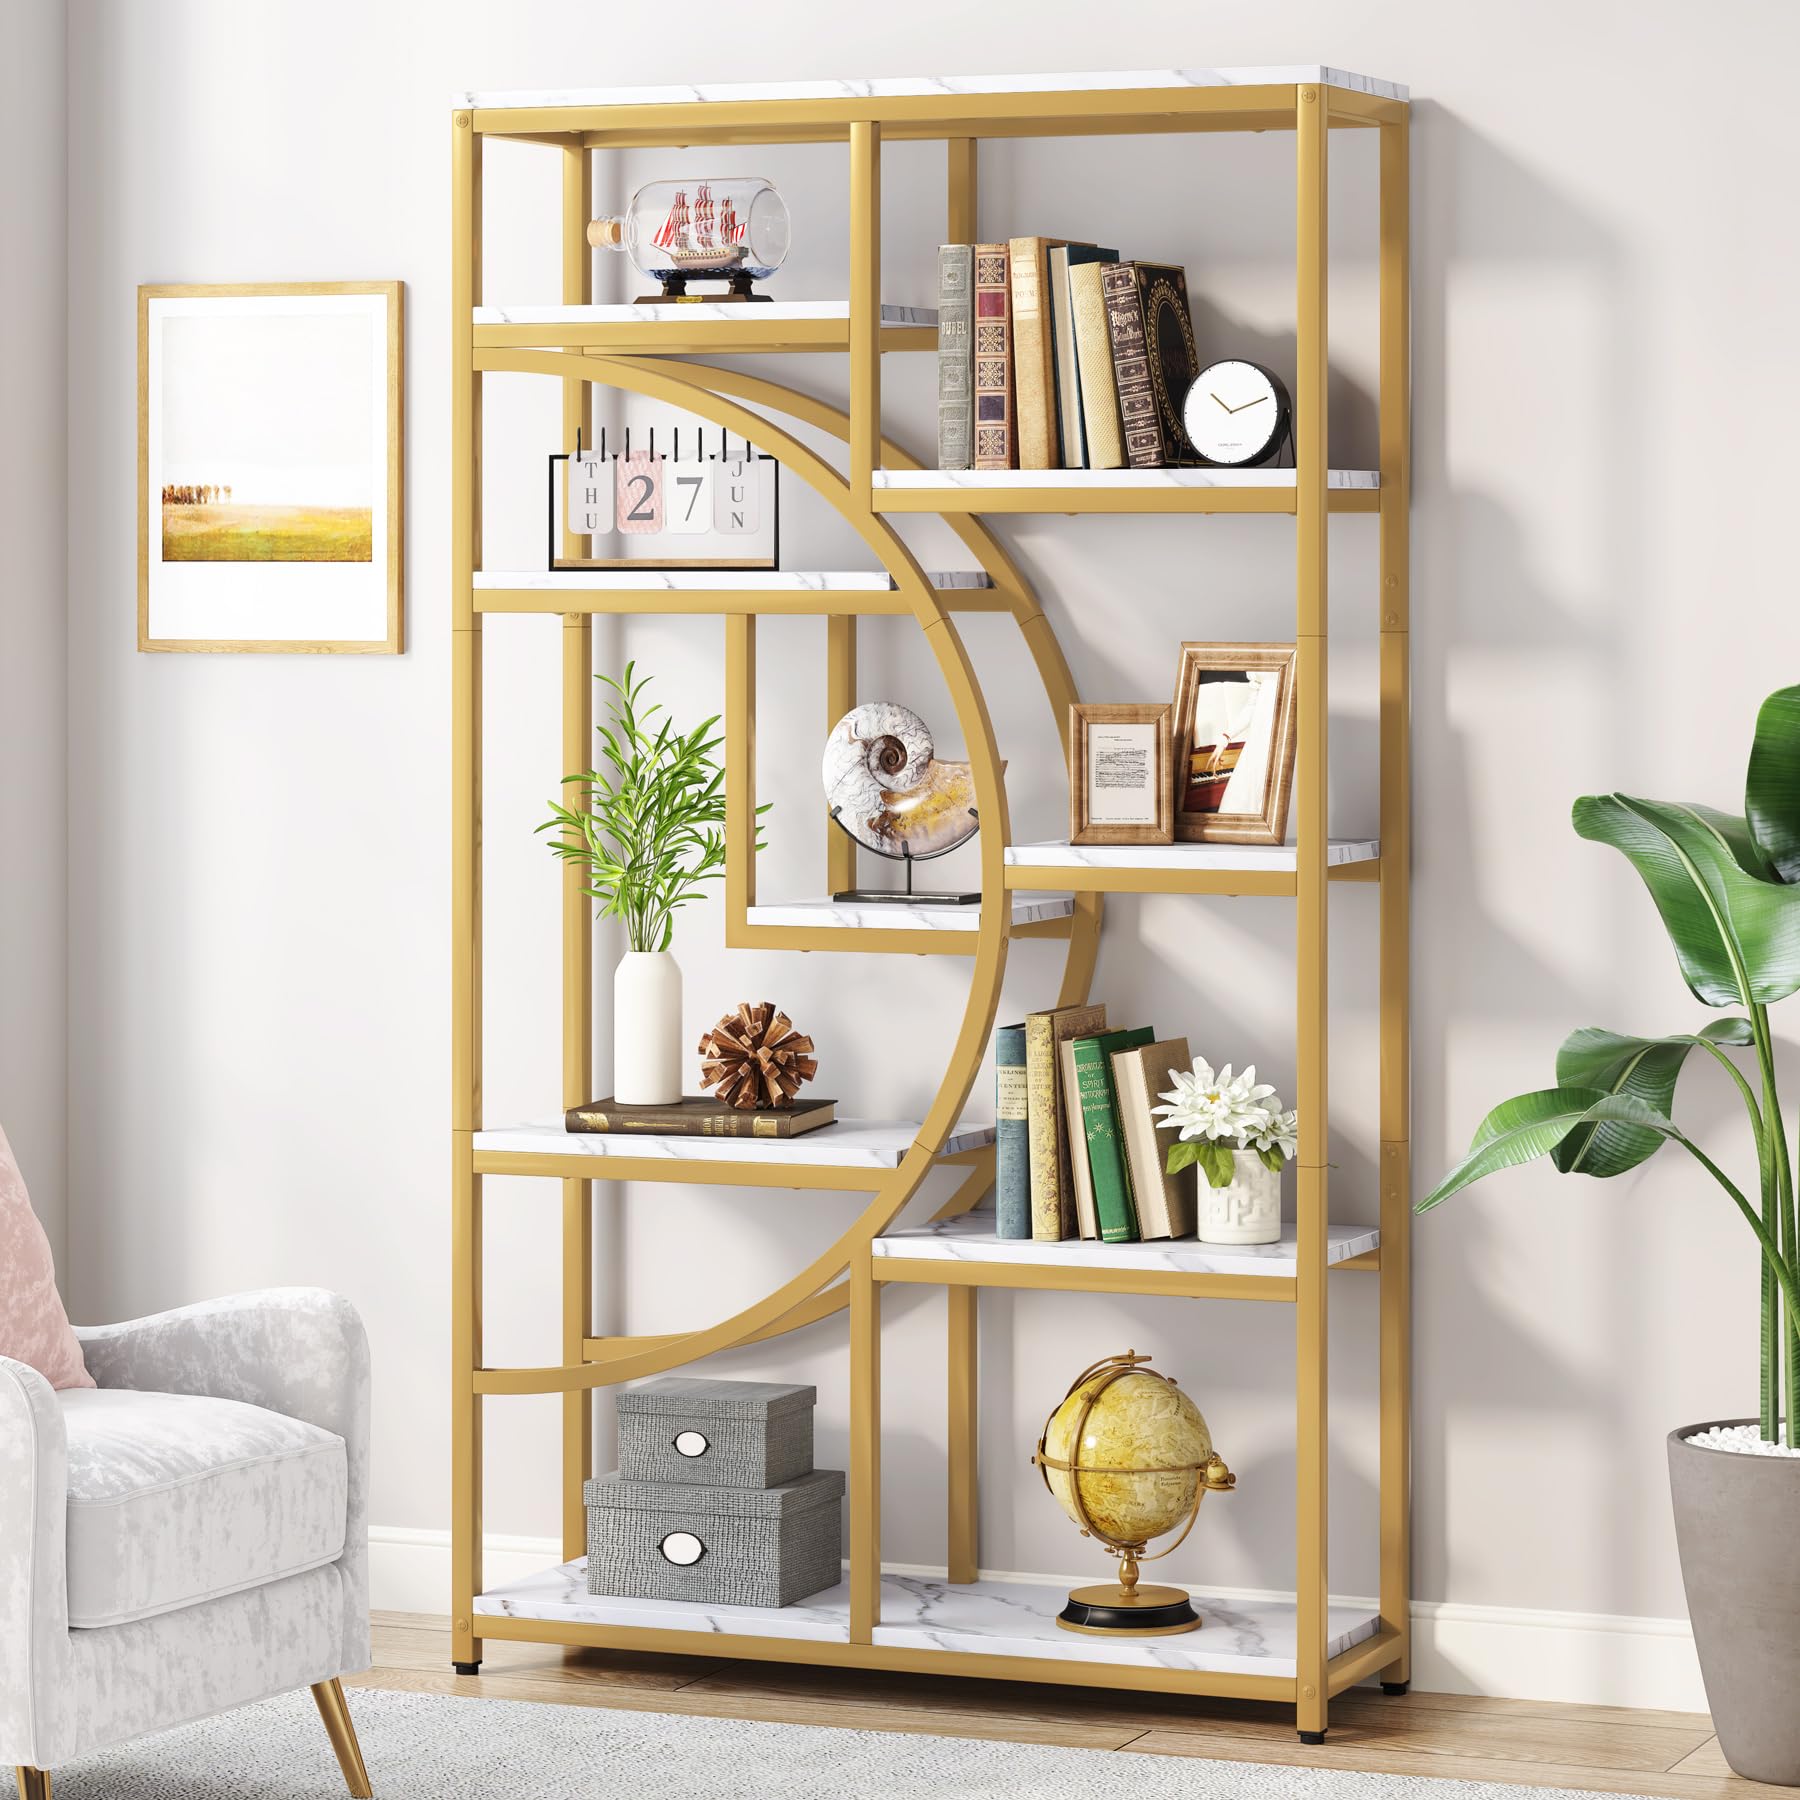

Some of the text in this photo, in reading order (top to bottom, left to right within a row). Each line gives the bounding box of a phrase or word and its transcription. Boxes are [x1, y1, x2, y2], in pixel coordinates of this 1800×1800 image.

[585, 462, 598, 529] THU
[731, 461, 744, 528] JUN
[1082, 1078, 1105, 1089] SPIRIT
